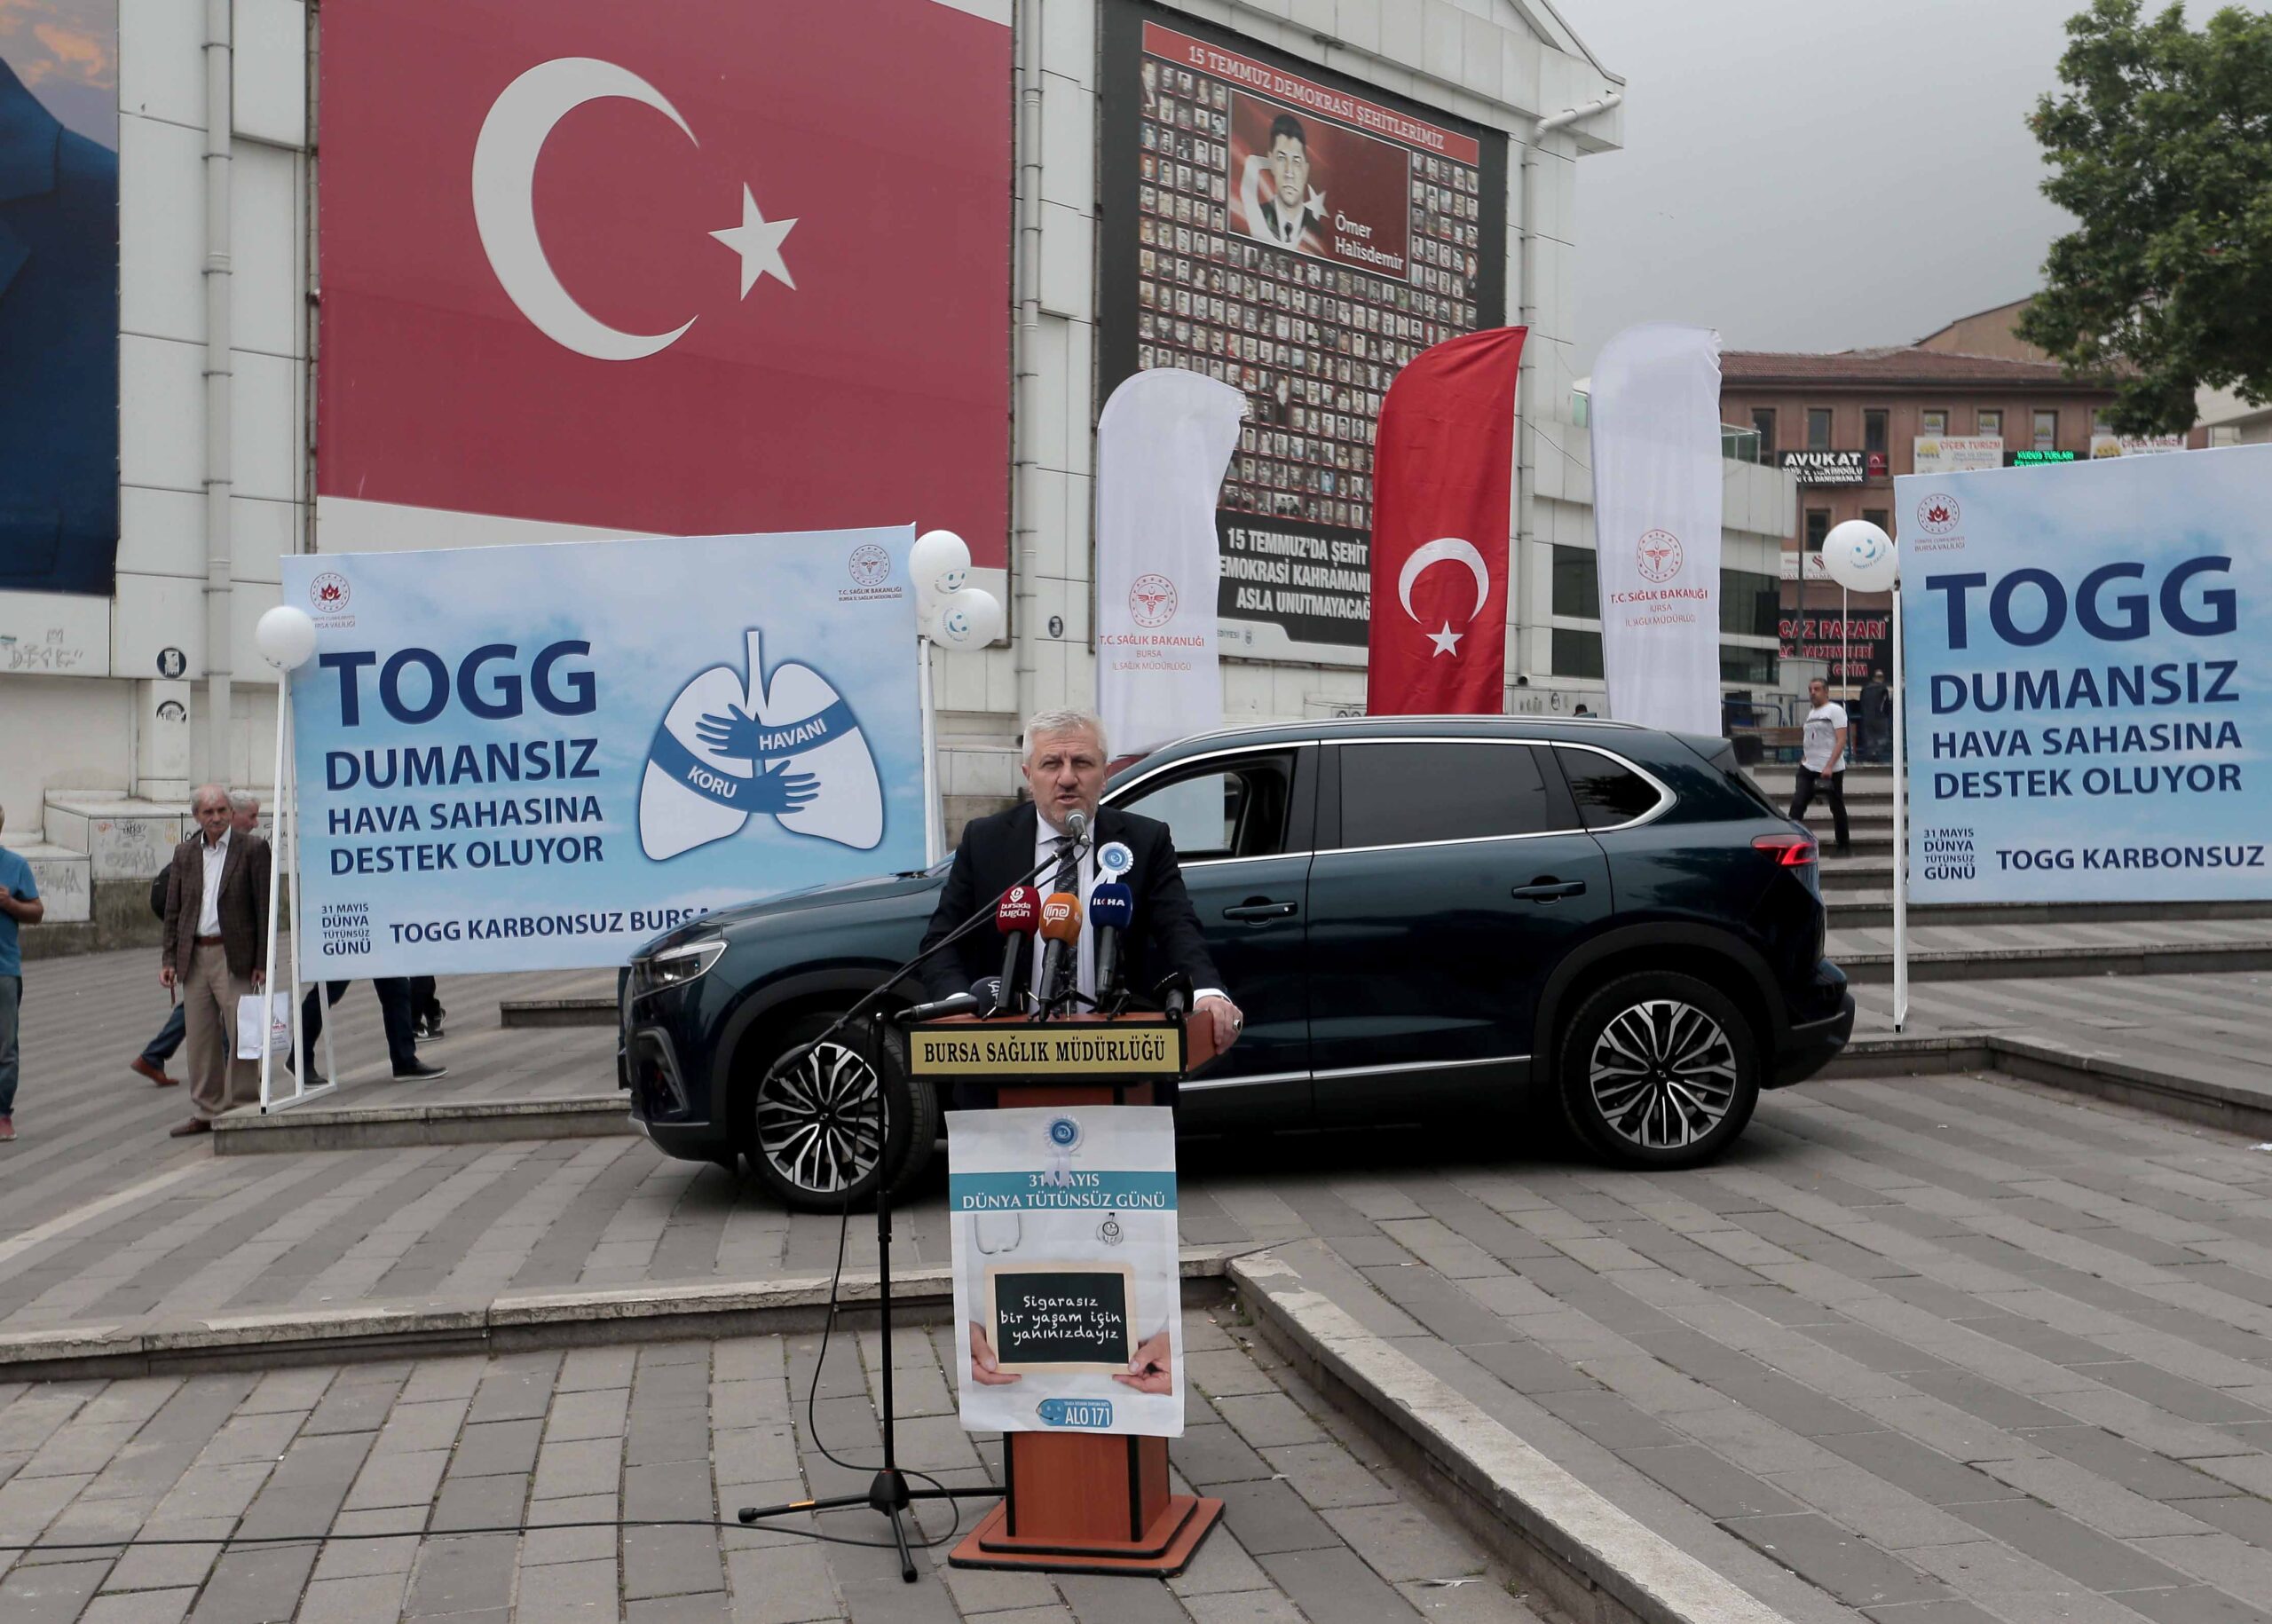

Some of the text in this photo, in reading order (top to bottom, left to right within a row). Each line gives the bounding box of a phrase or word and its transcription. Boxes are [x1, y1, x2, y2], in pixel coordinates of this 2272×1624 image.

[1188, 45, 1444, 149] 15 TEMMUZ DEMOKRASİ ŞEHİTLERİMİZ
[1335, 209, 1372, 239] Ömer
[1335, 235, 1404, 270] Halisdemir
[1785, 453, 1861, 467] AVUKAT
[1227, 527, 1245, 549] 15
[1331, 539, 1368, 567] ŞEHİT
[1219, 556, 1289, 584] EMOKRASİ
[1236, 587, 1370, 620] ASLA UNUTMAYACAĞ
[1925, 556, 2237, 650] TOGG
[1100, 634, 1204, 647] T.C. SAĞLIK BAKANLIĞI
[1833, 660, 1868, 677] GYİM
[319, 640, 596, 727] TOGG
[1929, 659, 2239, 714] DUMANSIZ
[759, 718, 827, 751] HAVANI
[1932, 721, 2243, 759] HAVA SAHASINA
[325, 738, 600, 791] DUMANSIZ
[687, 765, 738, 799] KORU
[1934, 763, 2243, 800] DESTEK OLUYOR
[328, 795, 604, 835] HAVA SAHASINA
[1923, 827, 1974, 839] 31 MAYIS
[330, 836, 604, 876] DESTEK OLUYOR
[1923, 838, 1974, 852] DÜNYA
[1924, 852, 1975, 863] TÜTÜNSÜZ
[1996, 846, 2265, 871] TOGG KARBONSUZ
[1924, 863, 1976, 880] GÜNÜ
[321, 903, 369, 914] 31 MAYIS
[999, 909, 1030, 918] bugün
[1046, 905, 1068, 917] line
[322, 914, 369, 928] DÜNYA
[390, 921, 461, 943] TOGG
[469, 912, 624, 940] KARBONSUZ
[323, 929, 370, 939] TÜTÜNSÜZ
[323, 938, 371, 956] GÜNÜ
[924, 1034, 1165, 1062] BURSA SAĞLIK MÜDÜRLÜĞÜ
[1029, 1174, 1044, 1186] 31
[963, 1191, 1165, 1209] DÜNYA TÜTÜNSÜZ GÜNÜ
[1023, 1296, 1098, 1311] Sigarasız
[1000, 1310, 1121, 1329] bir yaşam için
[1013, 1325, 1118, 1345] yanınızdayız
[1065, 1407, 1109, 1426] ALO 171
